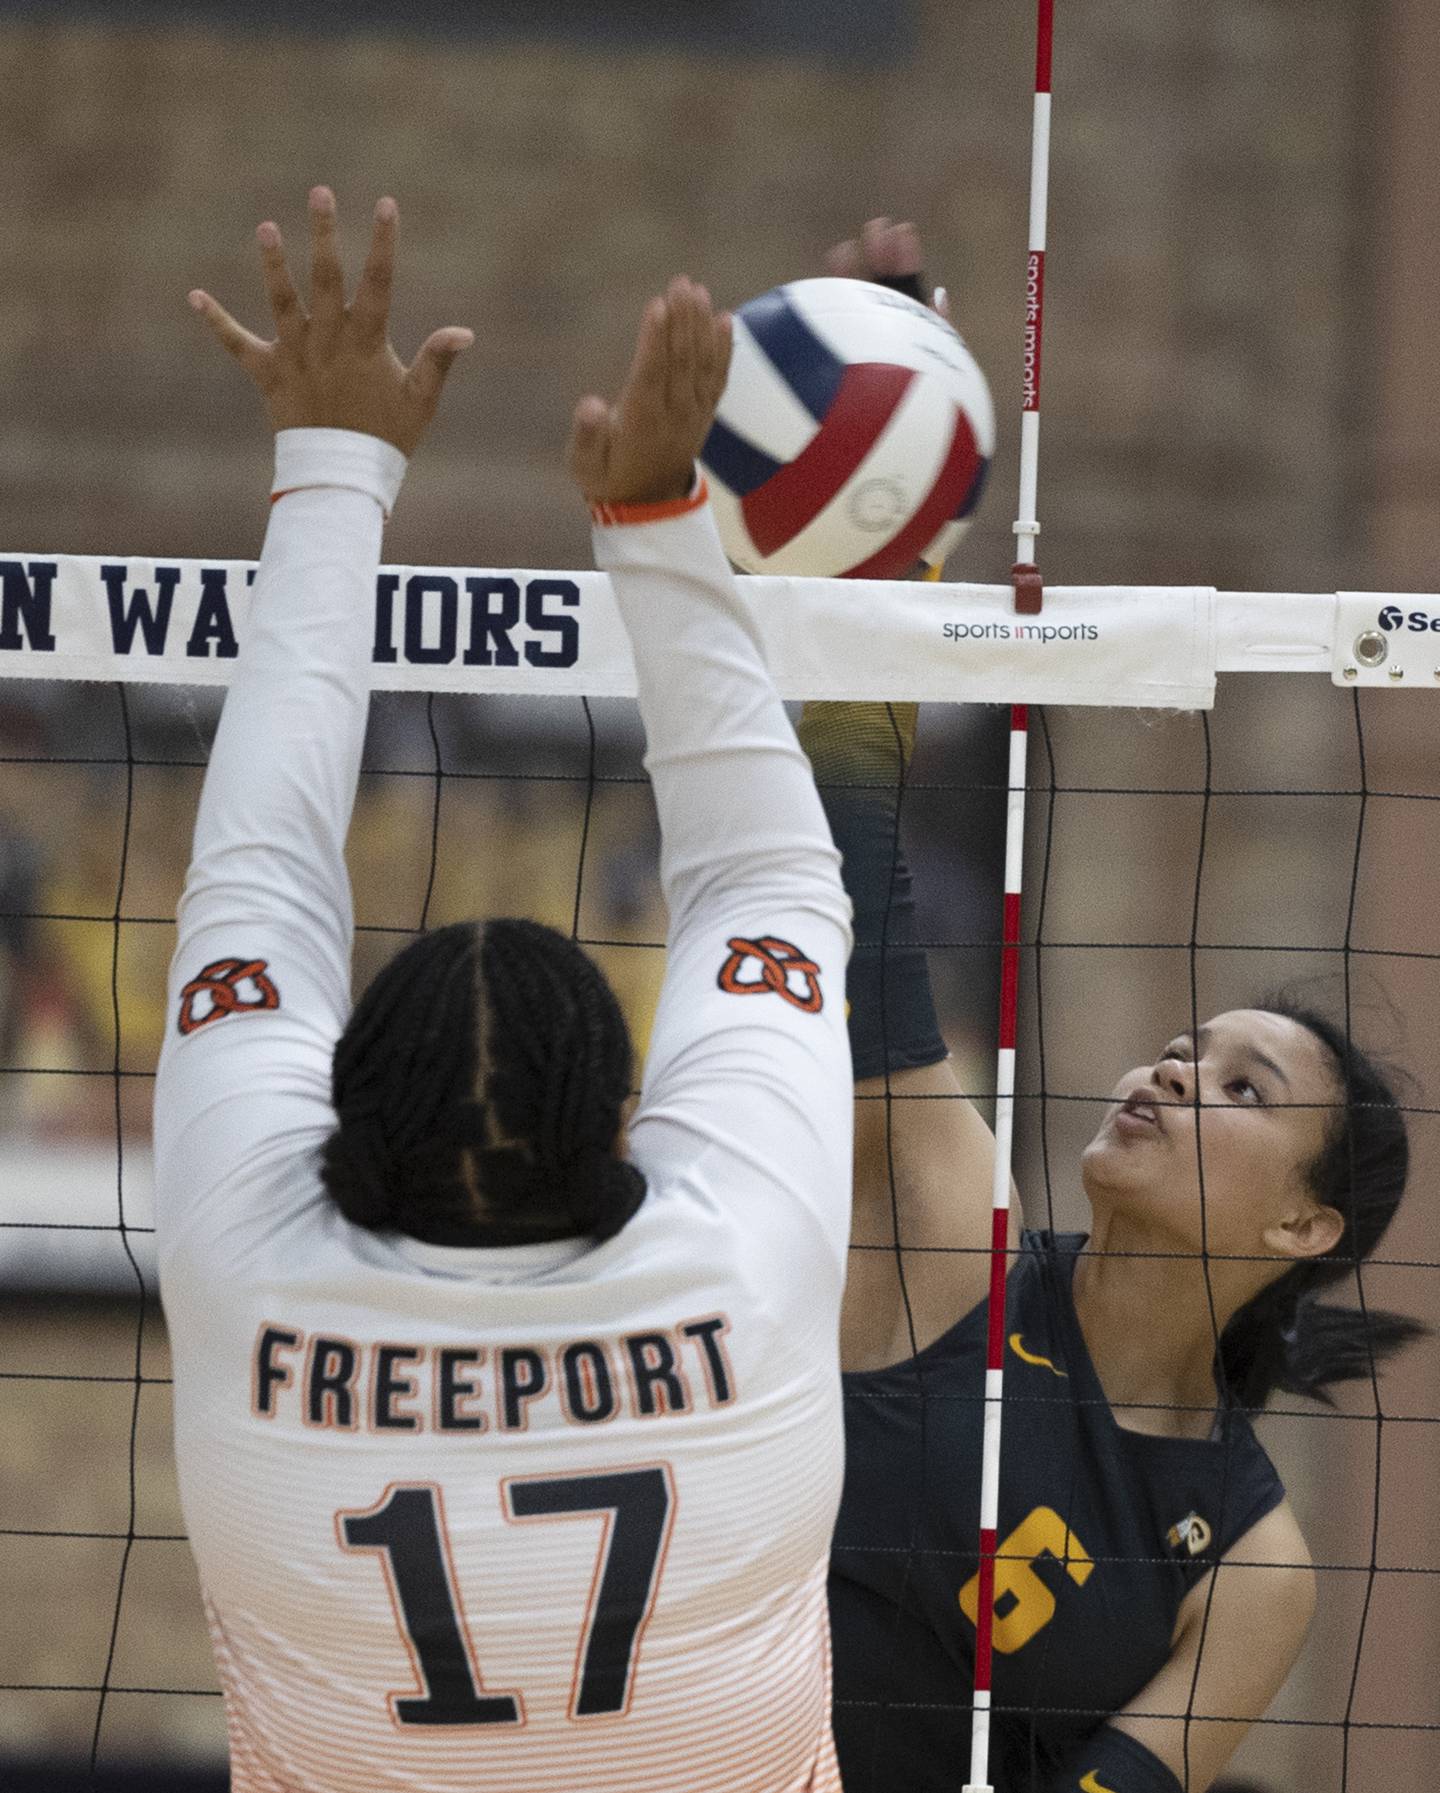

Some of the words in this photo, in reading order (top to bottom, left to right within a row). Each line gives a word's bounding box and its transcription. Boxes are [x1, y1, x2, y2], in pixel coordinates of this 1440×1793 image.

[1026, 254, 1040, 322] sports
[1022, 324, 1037, 409] imports
[0, 561, 58, 652] N
[100, 564, 582, 669] WAIORS
[942, 622, 1011, 642] sports
[1014, 623, 1099, 644] imports
[252, 1313, 736, 1434] FREEPORT
[335, 1460, 678, 1730] 17
[958, 1505, 1096, 1655] 6
